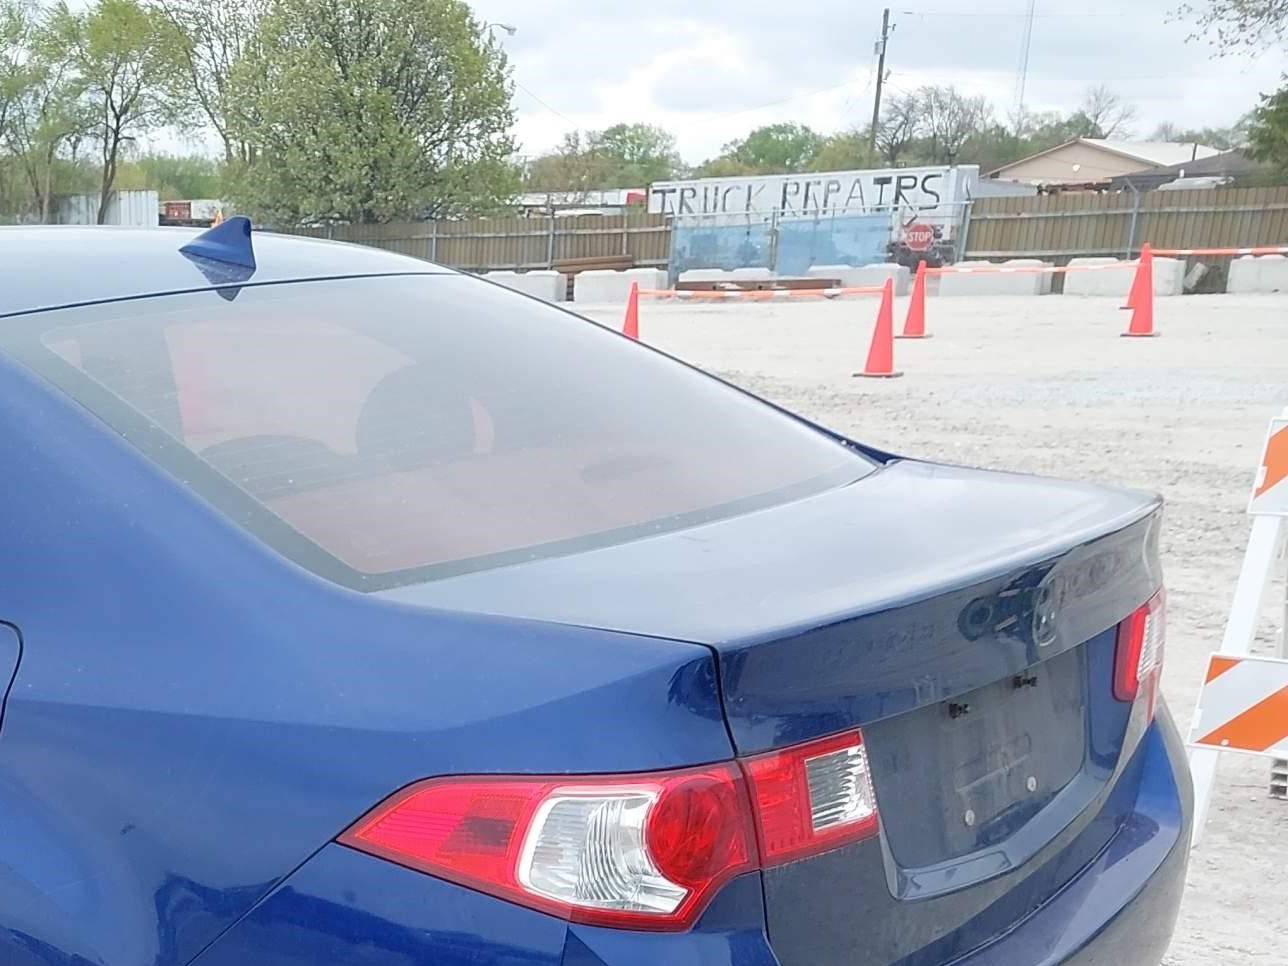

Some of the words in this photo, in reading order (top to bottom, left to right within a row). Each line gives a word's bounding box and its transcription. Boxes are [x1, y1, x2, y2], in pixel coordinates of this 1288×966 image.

[652, 183, 766, 219] TRUCK
[780, 174, 942, 217] REPAIRS
[908, 231, 931, 242] STOP
